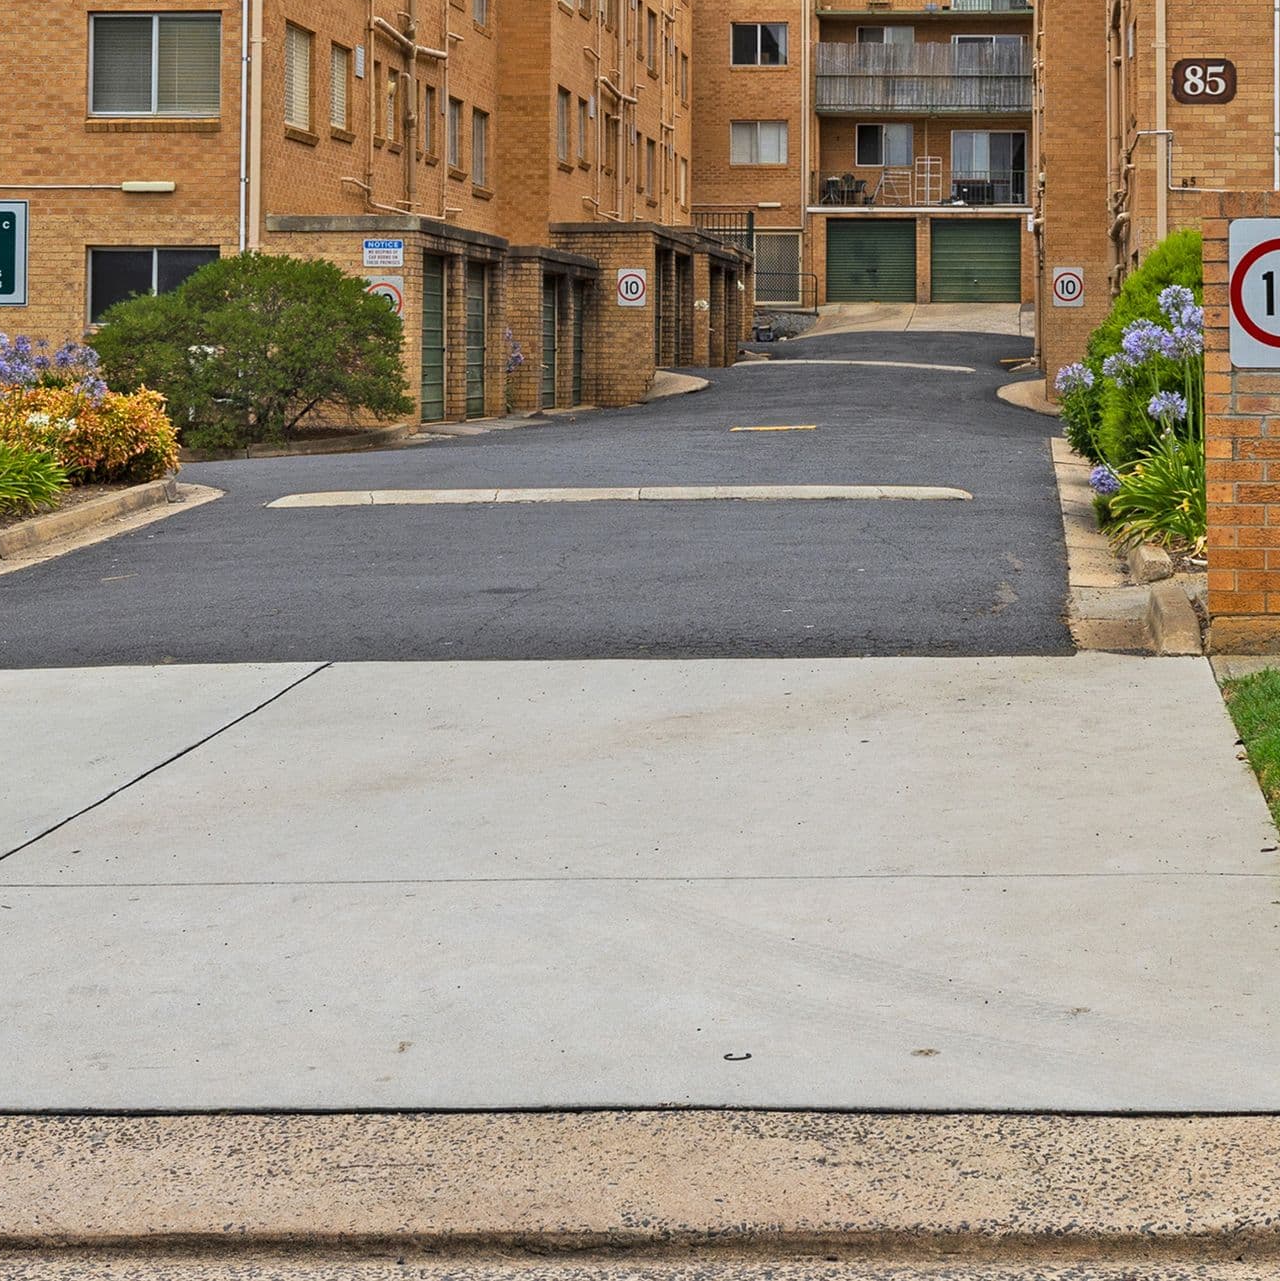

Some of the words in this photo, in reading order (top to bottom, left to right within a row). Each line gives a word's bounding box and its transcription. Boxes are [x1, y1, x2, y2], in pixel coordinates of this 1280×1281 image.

[1183, 65, 1226, 95] 85
[2, 220, 10, 230] C
[625, 281, 639, 295] 10
[1060, 280, 1076, 295] 10
